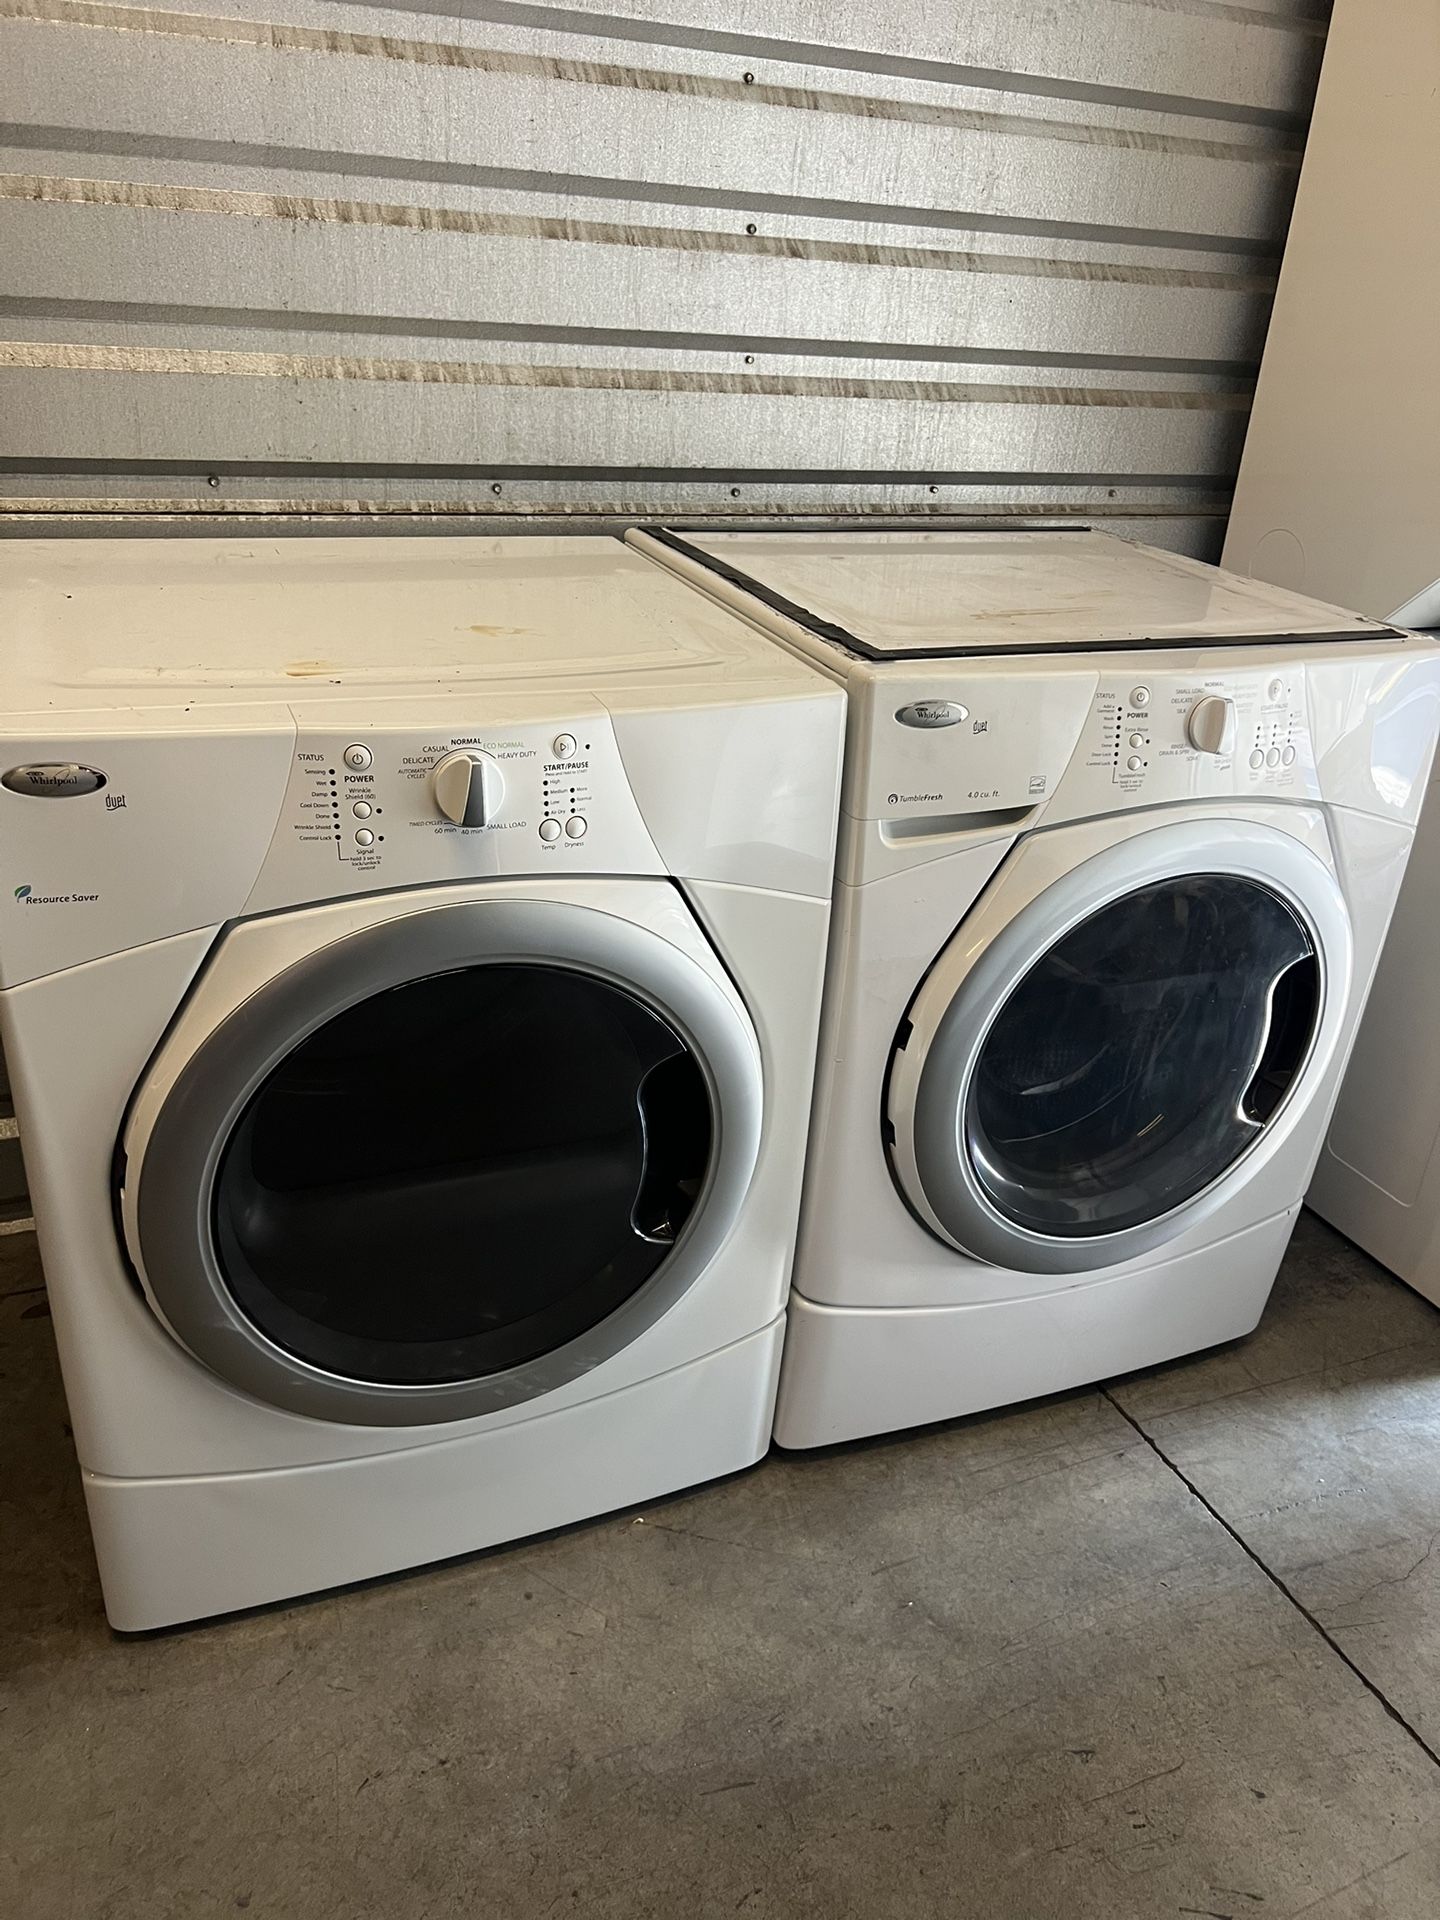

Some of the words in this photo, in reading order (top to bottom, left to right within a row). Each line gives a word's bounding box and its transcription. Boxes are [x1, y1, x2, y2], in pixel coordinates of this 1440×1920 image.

[916, 710, 950, 720] Whirlpool
[451, 738, 481, 746] NORMAL
[497, 741, 525, 749] NORMAL
[497, 752, 518, 760] HEAVY
[402, 757, 434, 765] DELICATE
[543, 761, 589, 772] START/PAUSE
[398, 767, 427, 775] AUTOMATIC
[29, 776, 78, 787] Whirlpool
[344, 775, 375, 783] POWER
[899, 794, 943, 803] TumbleFresh
[967, 791, 979, 799] 4.0
[979, 791, 991, 799] cu.
[992, 790, 1000, 798] ft.
[105, 794, 127, 810] duet
[486, 823, 507, 831] SMALL
[508, 821, 527, 829] LOAD
[541, 844, 556, 852] Temp
[564, 841, 584, 849] Dryness
[26, 894, 70, 905] Resource
[72, 892, 99, 903] Saver
